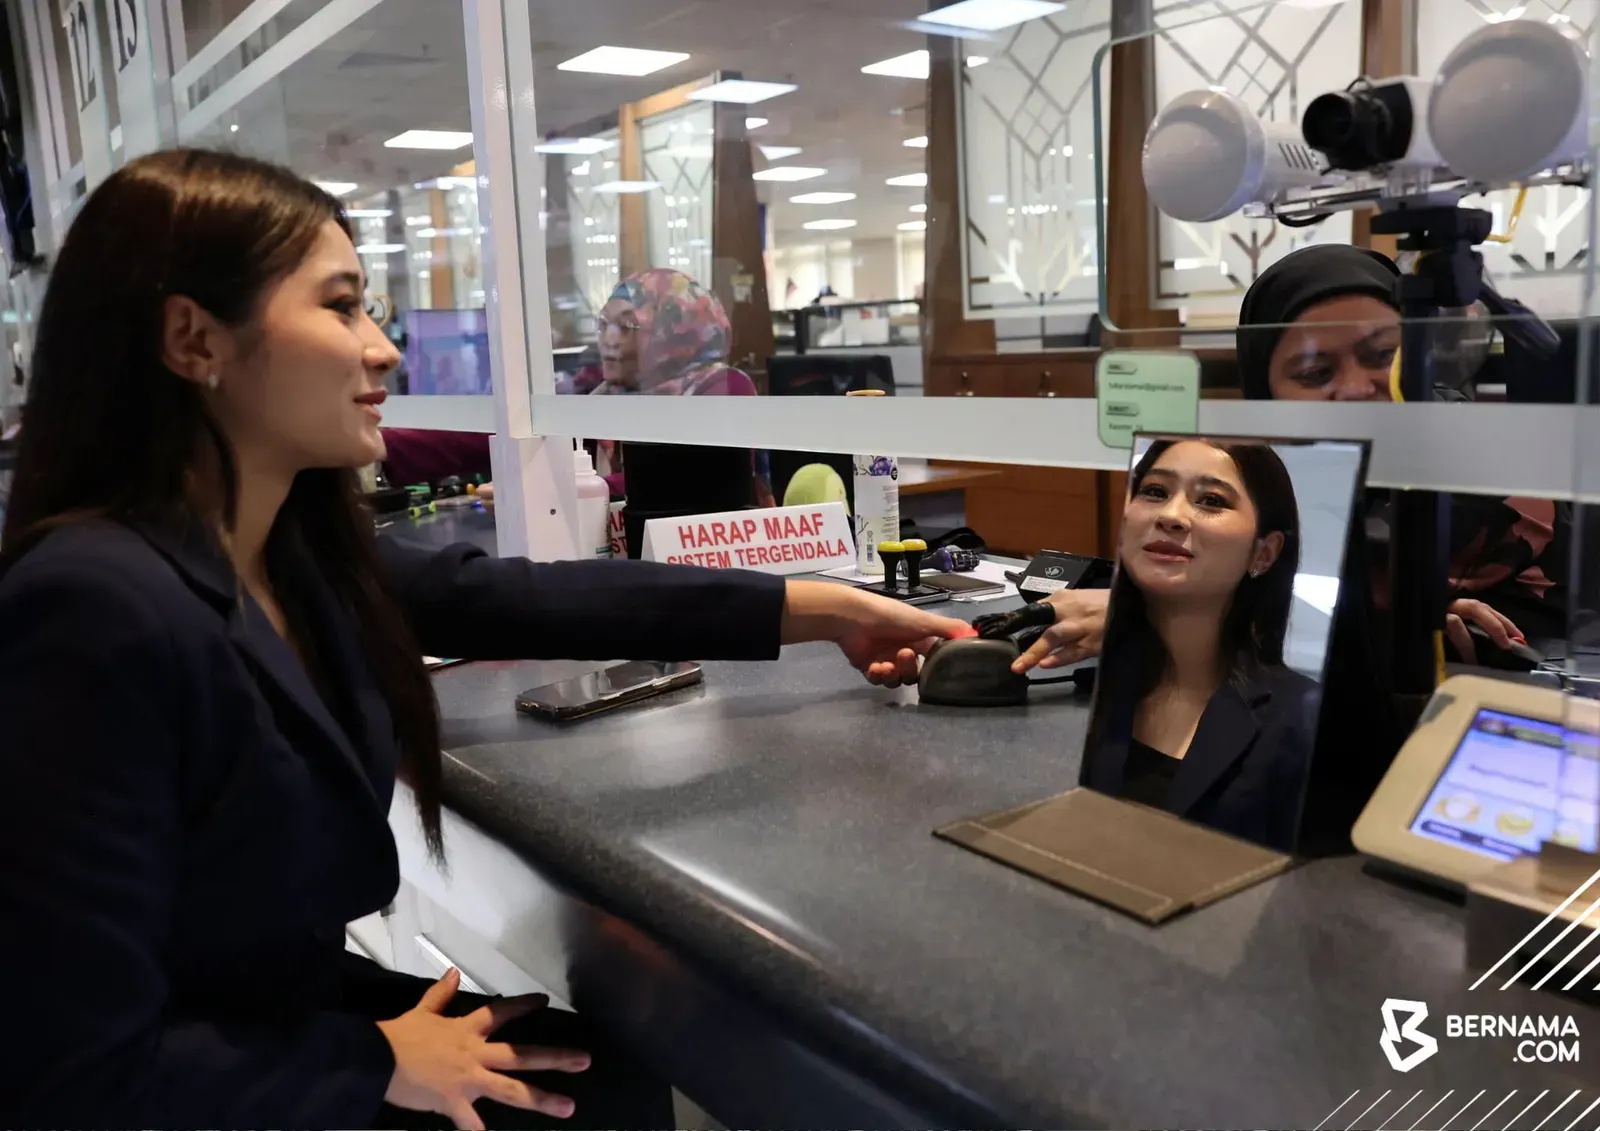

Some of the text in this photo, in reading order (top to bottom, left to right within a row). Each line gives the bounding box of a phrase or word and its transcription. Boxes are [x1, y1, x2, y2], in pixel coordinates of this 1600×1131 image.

[70, 1, 97, 112] 12
[678, 512, 824, 549] HARAP MAAF
[735, 538, 849, 567] TERGENDALA
